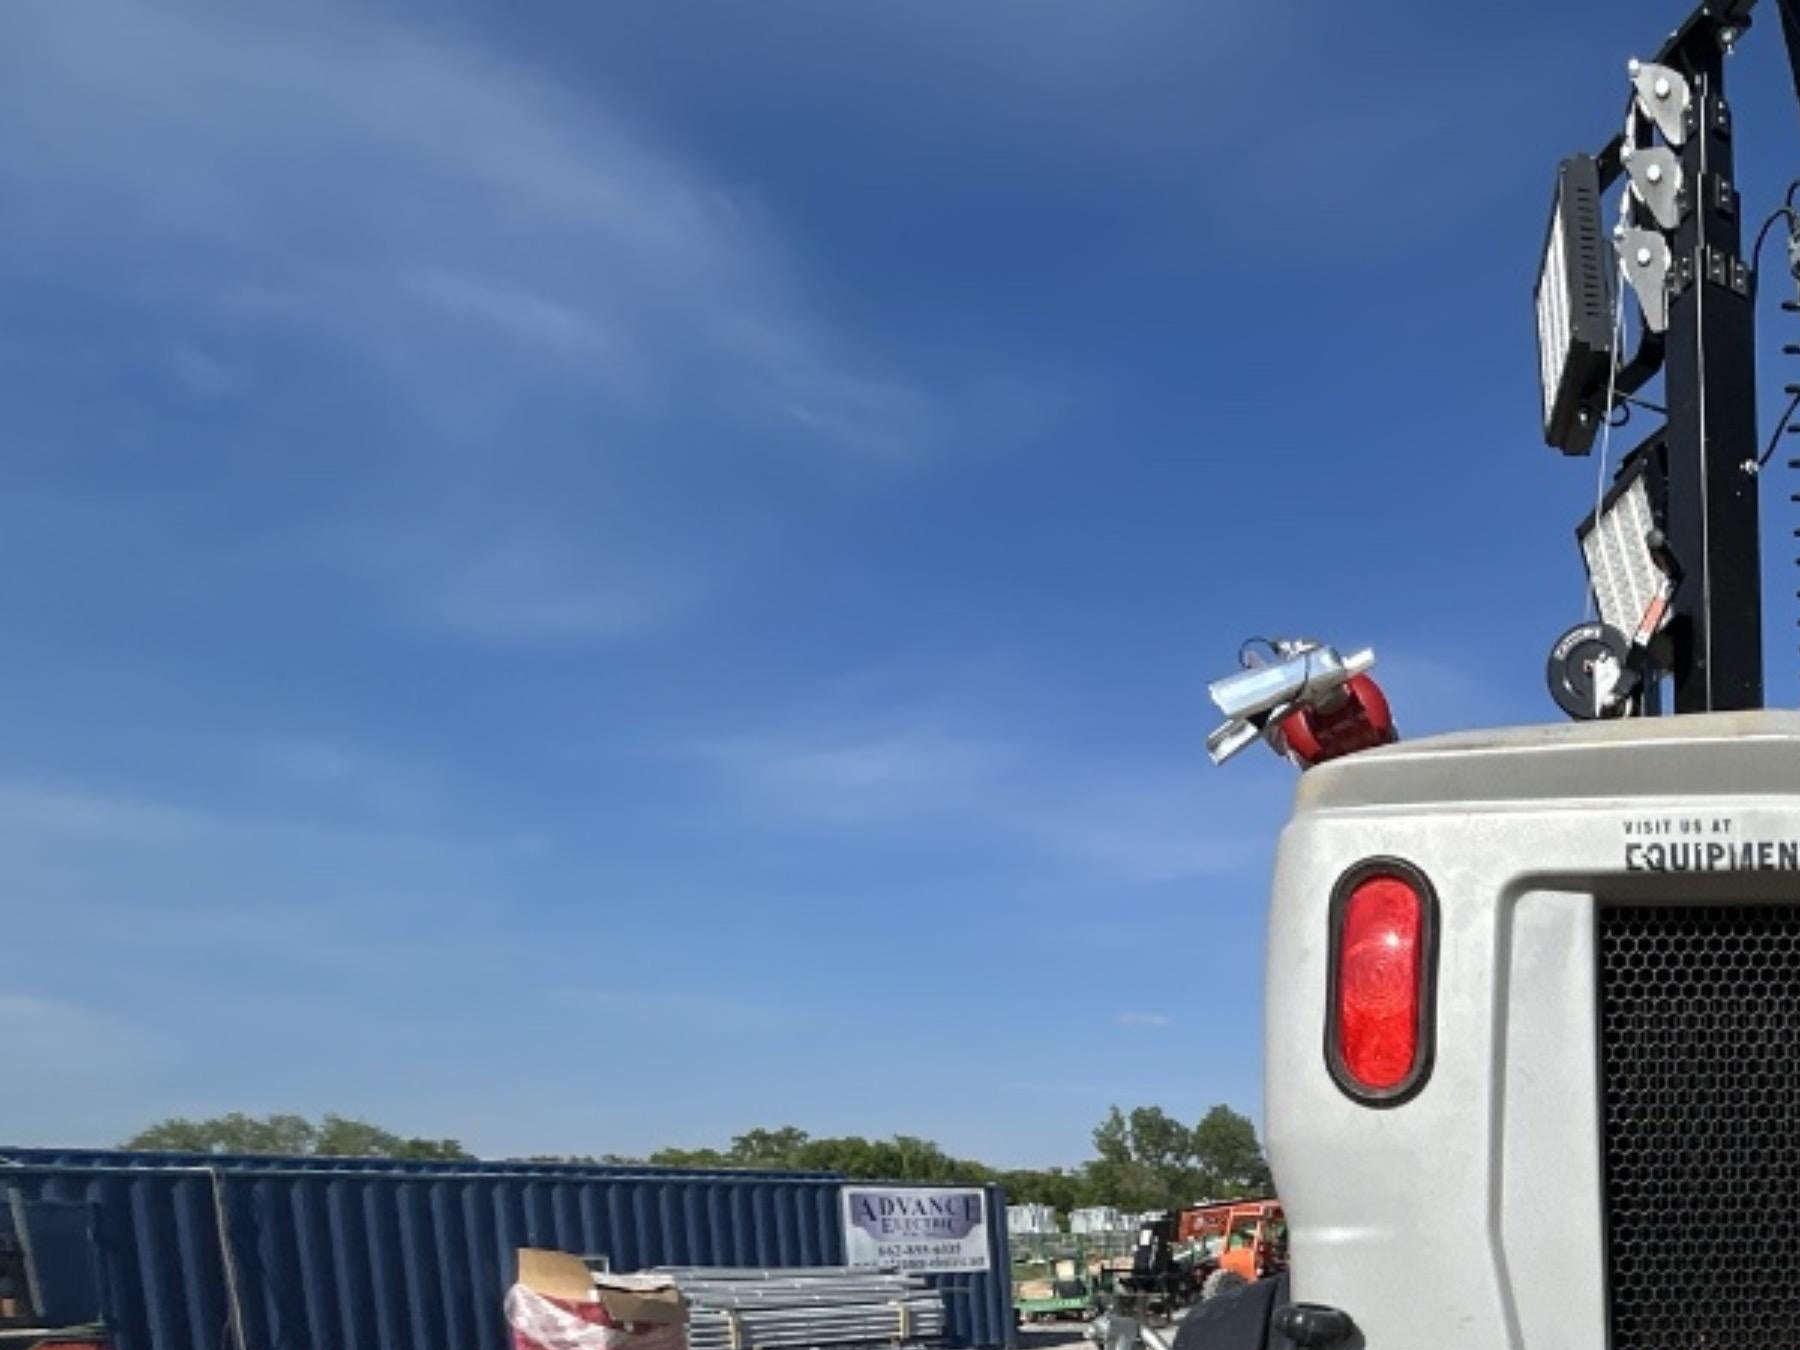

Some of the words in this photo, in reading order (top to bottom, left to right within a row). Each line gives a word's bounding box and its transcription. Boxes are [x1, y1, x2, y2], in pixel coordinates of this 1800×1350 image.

[1622, 819, 1672, 835] VISIT
[1679, 818, 1703, 834] US
[1711, 817, 1733, 834] AT
